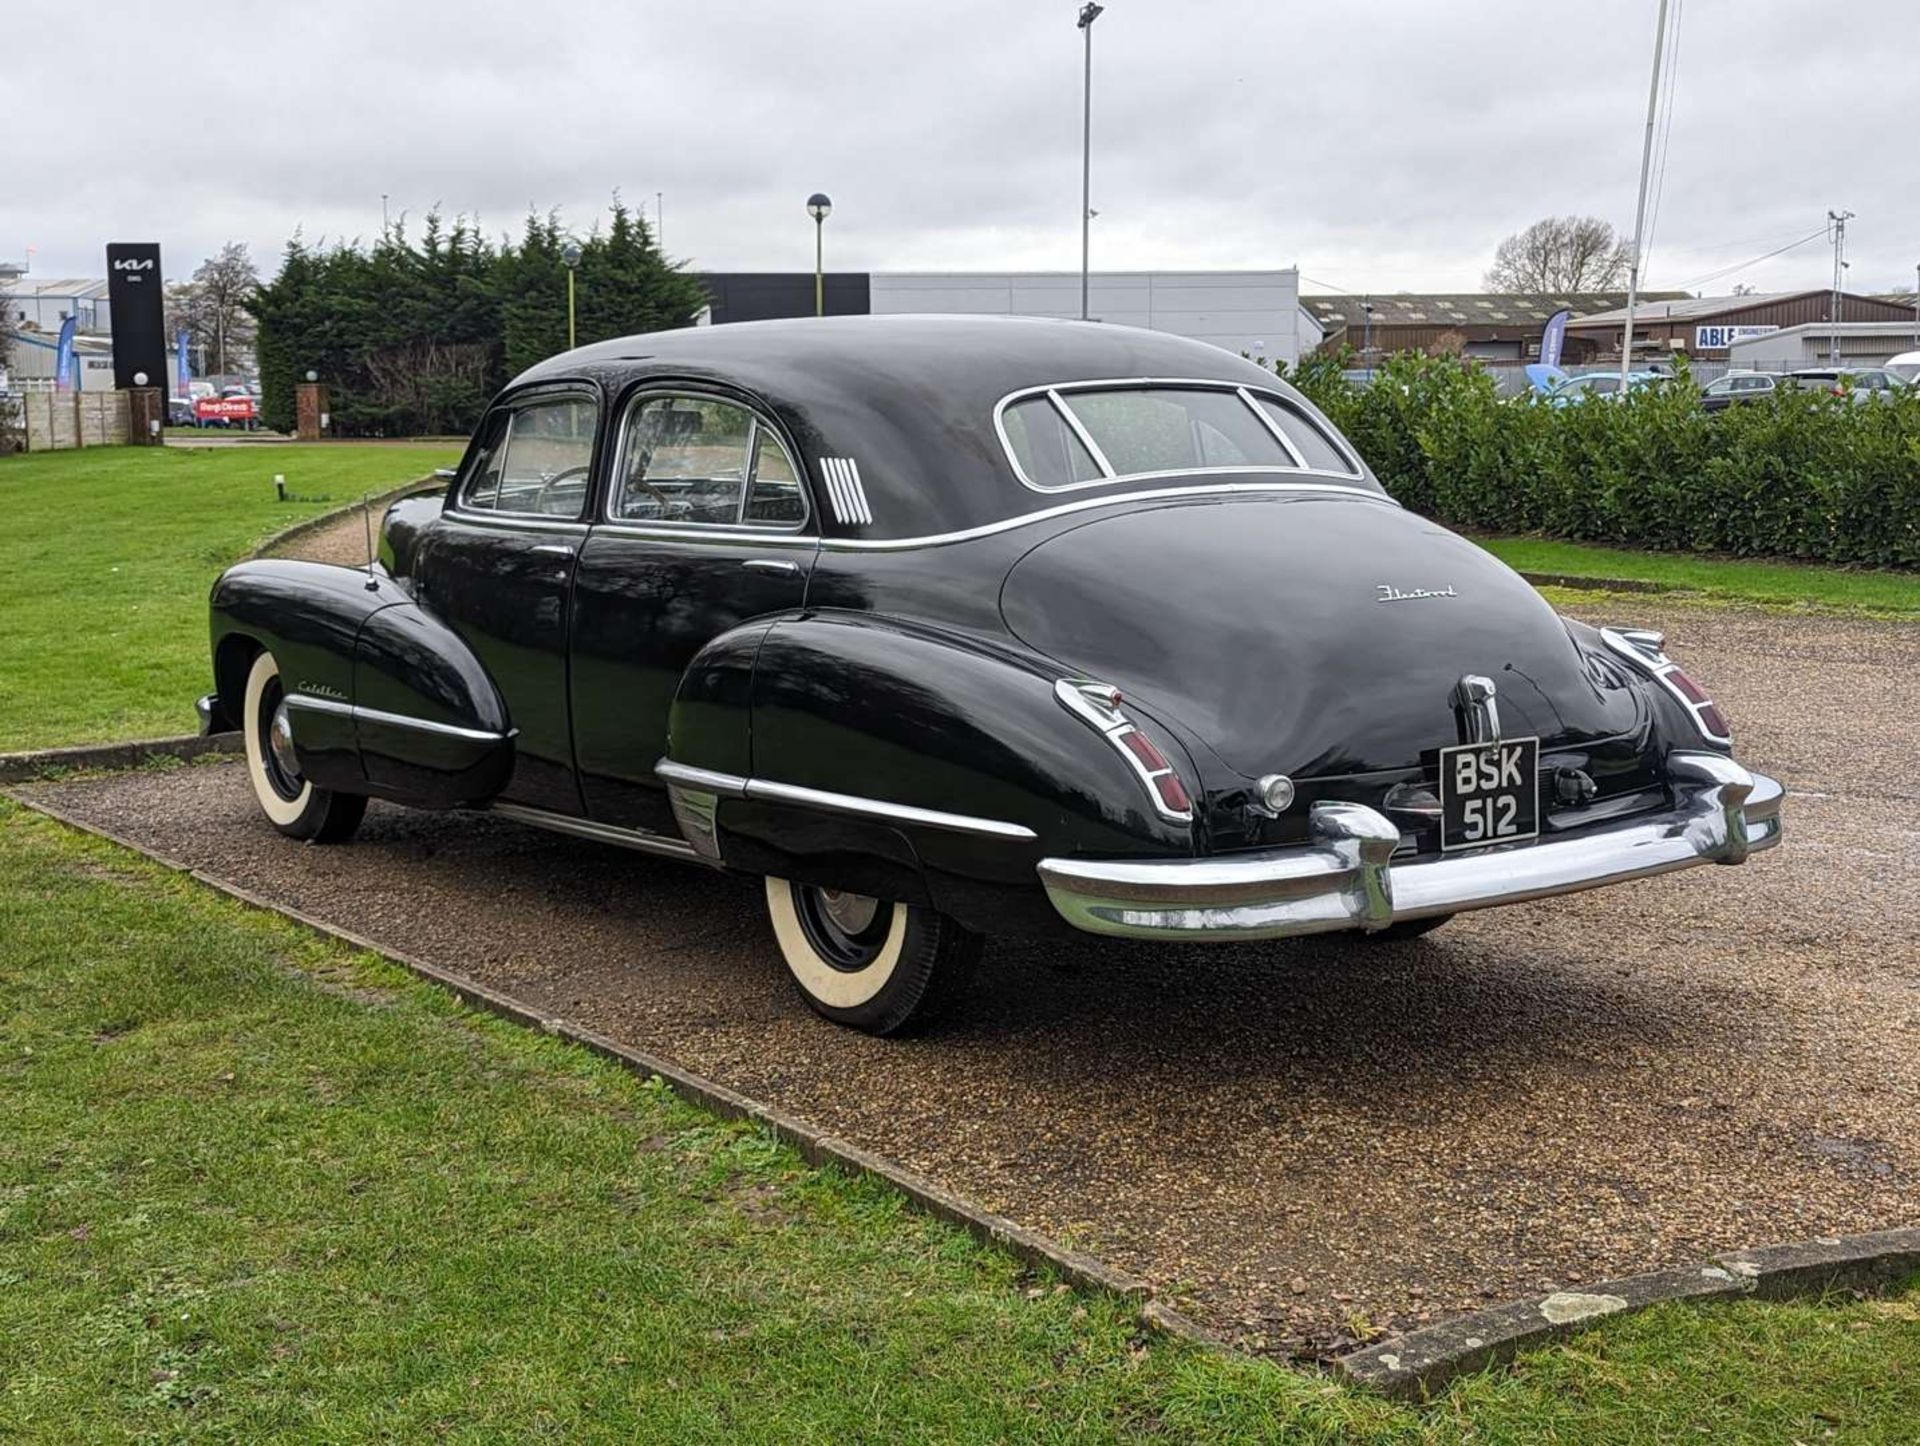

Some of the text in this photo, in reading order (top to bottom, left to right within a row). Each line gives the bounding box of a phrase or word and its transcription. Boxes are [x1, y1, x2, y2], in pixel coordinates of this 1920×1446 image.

[114, 259, 153, 270] KIA
[1699, 327, 1736, 347] ABLE
[1377, 585, 1458, 601] Fleetwood
[298, 680, 348, 700] Cadillac
[1456, 746, 1522, 795] BSK
[1464, 795, 1517, 840] 512
